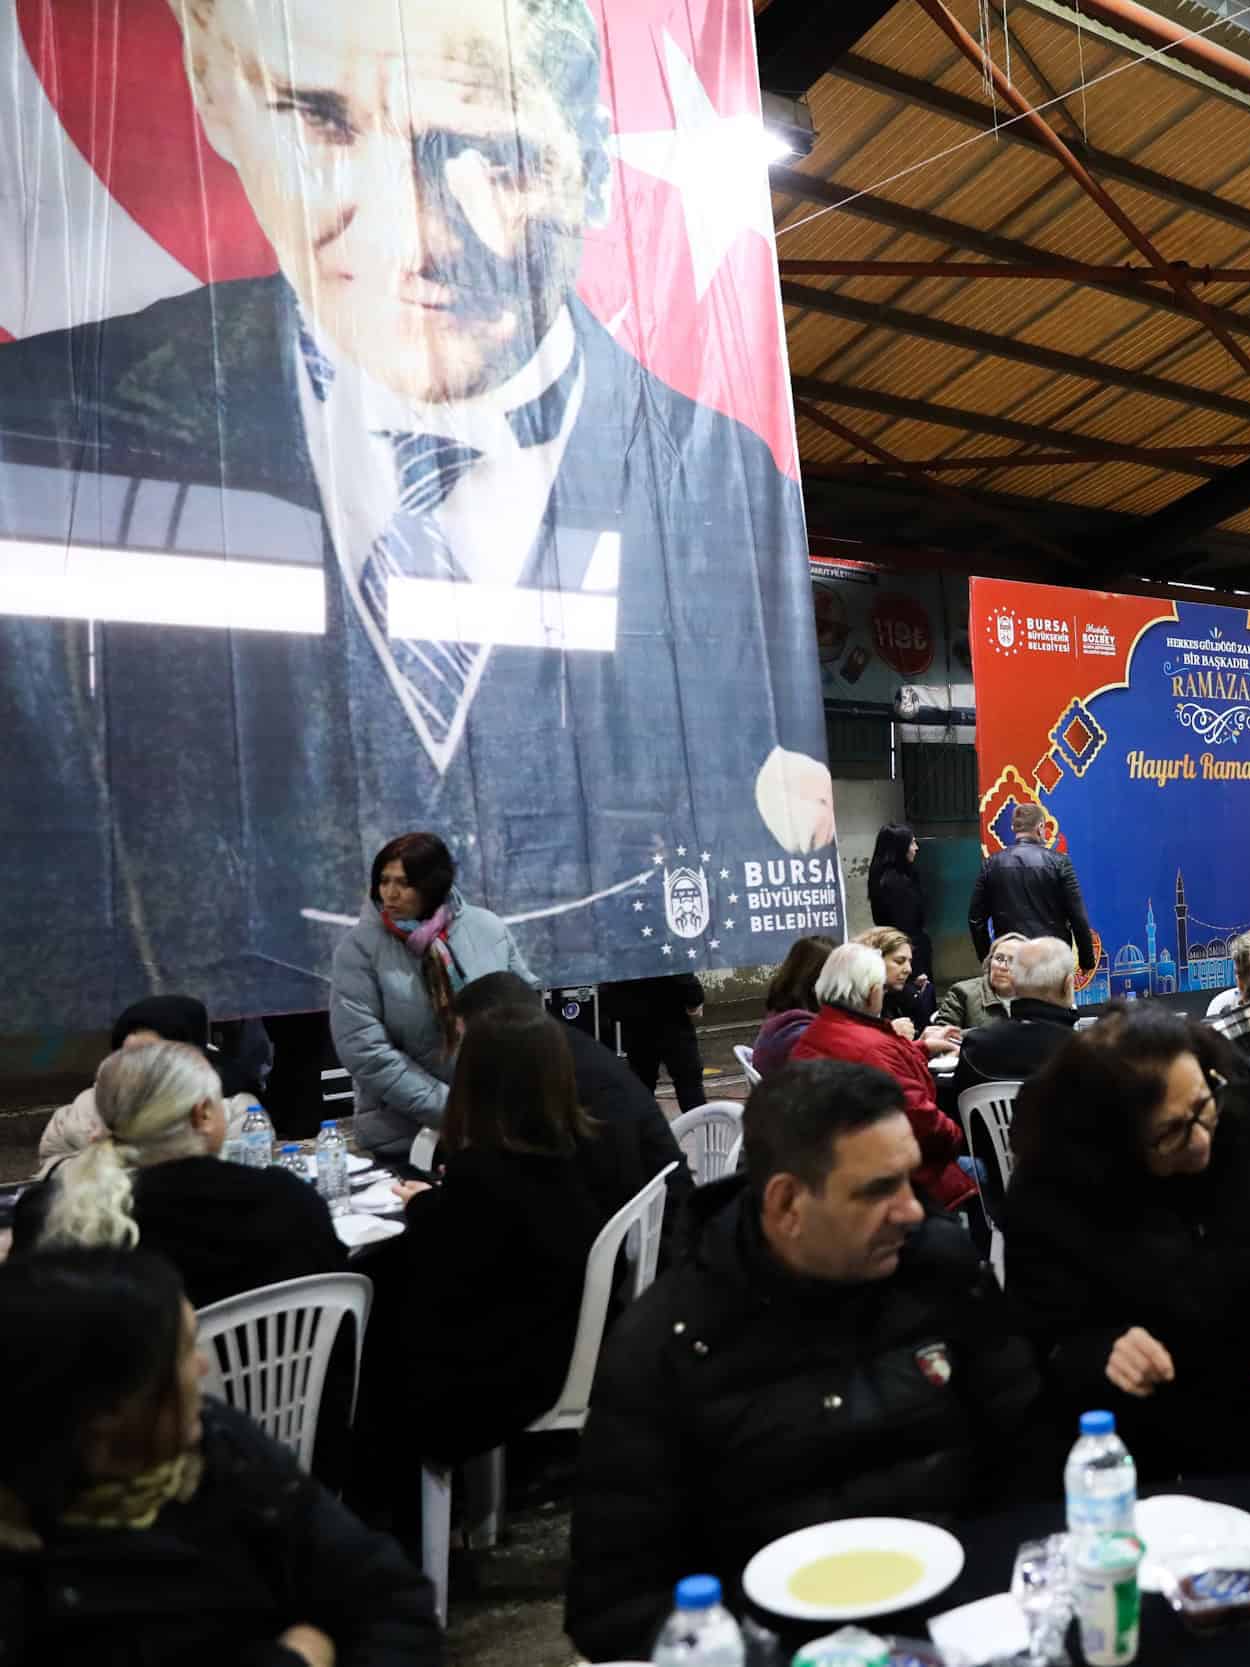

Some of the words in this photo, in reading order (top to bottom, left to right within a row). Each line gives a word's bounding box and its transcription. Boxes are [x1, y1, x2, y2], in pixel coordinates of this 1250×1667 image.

[1026, 617, 1069, 632] BURSA
[1166, 637, 1199, 650] HERKES
[1199, 639, 1237, 653] GÜLDÜĞÜ
[1183, 651, 1200, 665] BİR
[1201, 655, 1249, 670] BAŞKADIR
[1126, 750, 1197, 788] Hayırlı
[743, 858, 836, 888] BURSA
[750, 905, 838, 933] BELEDİYESİ
